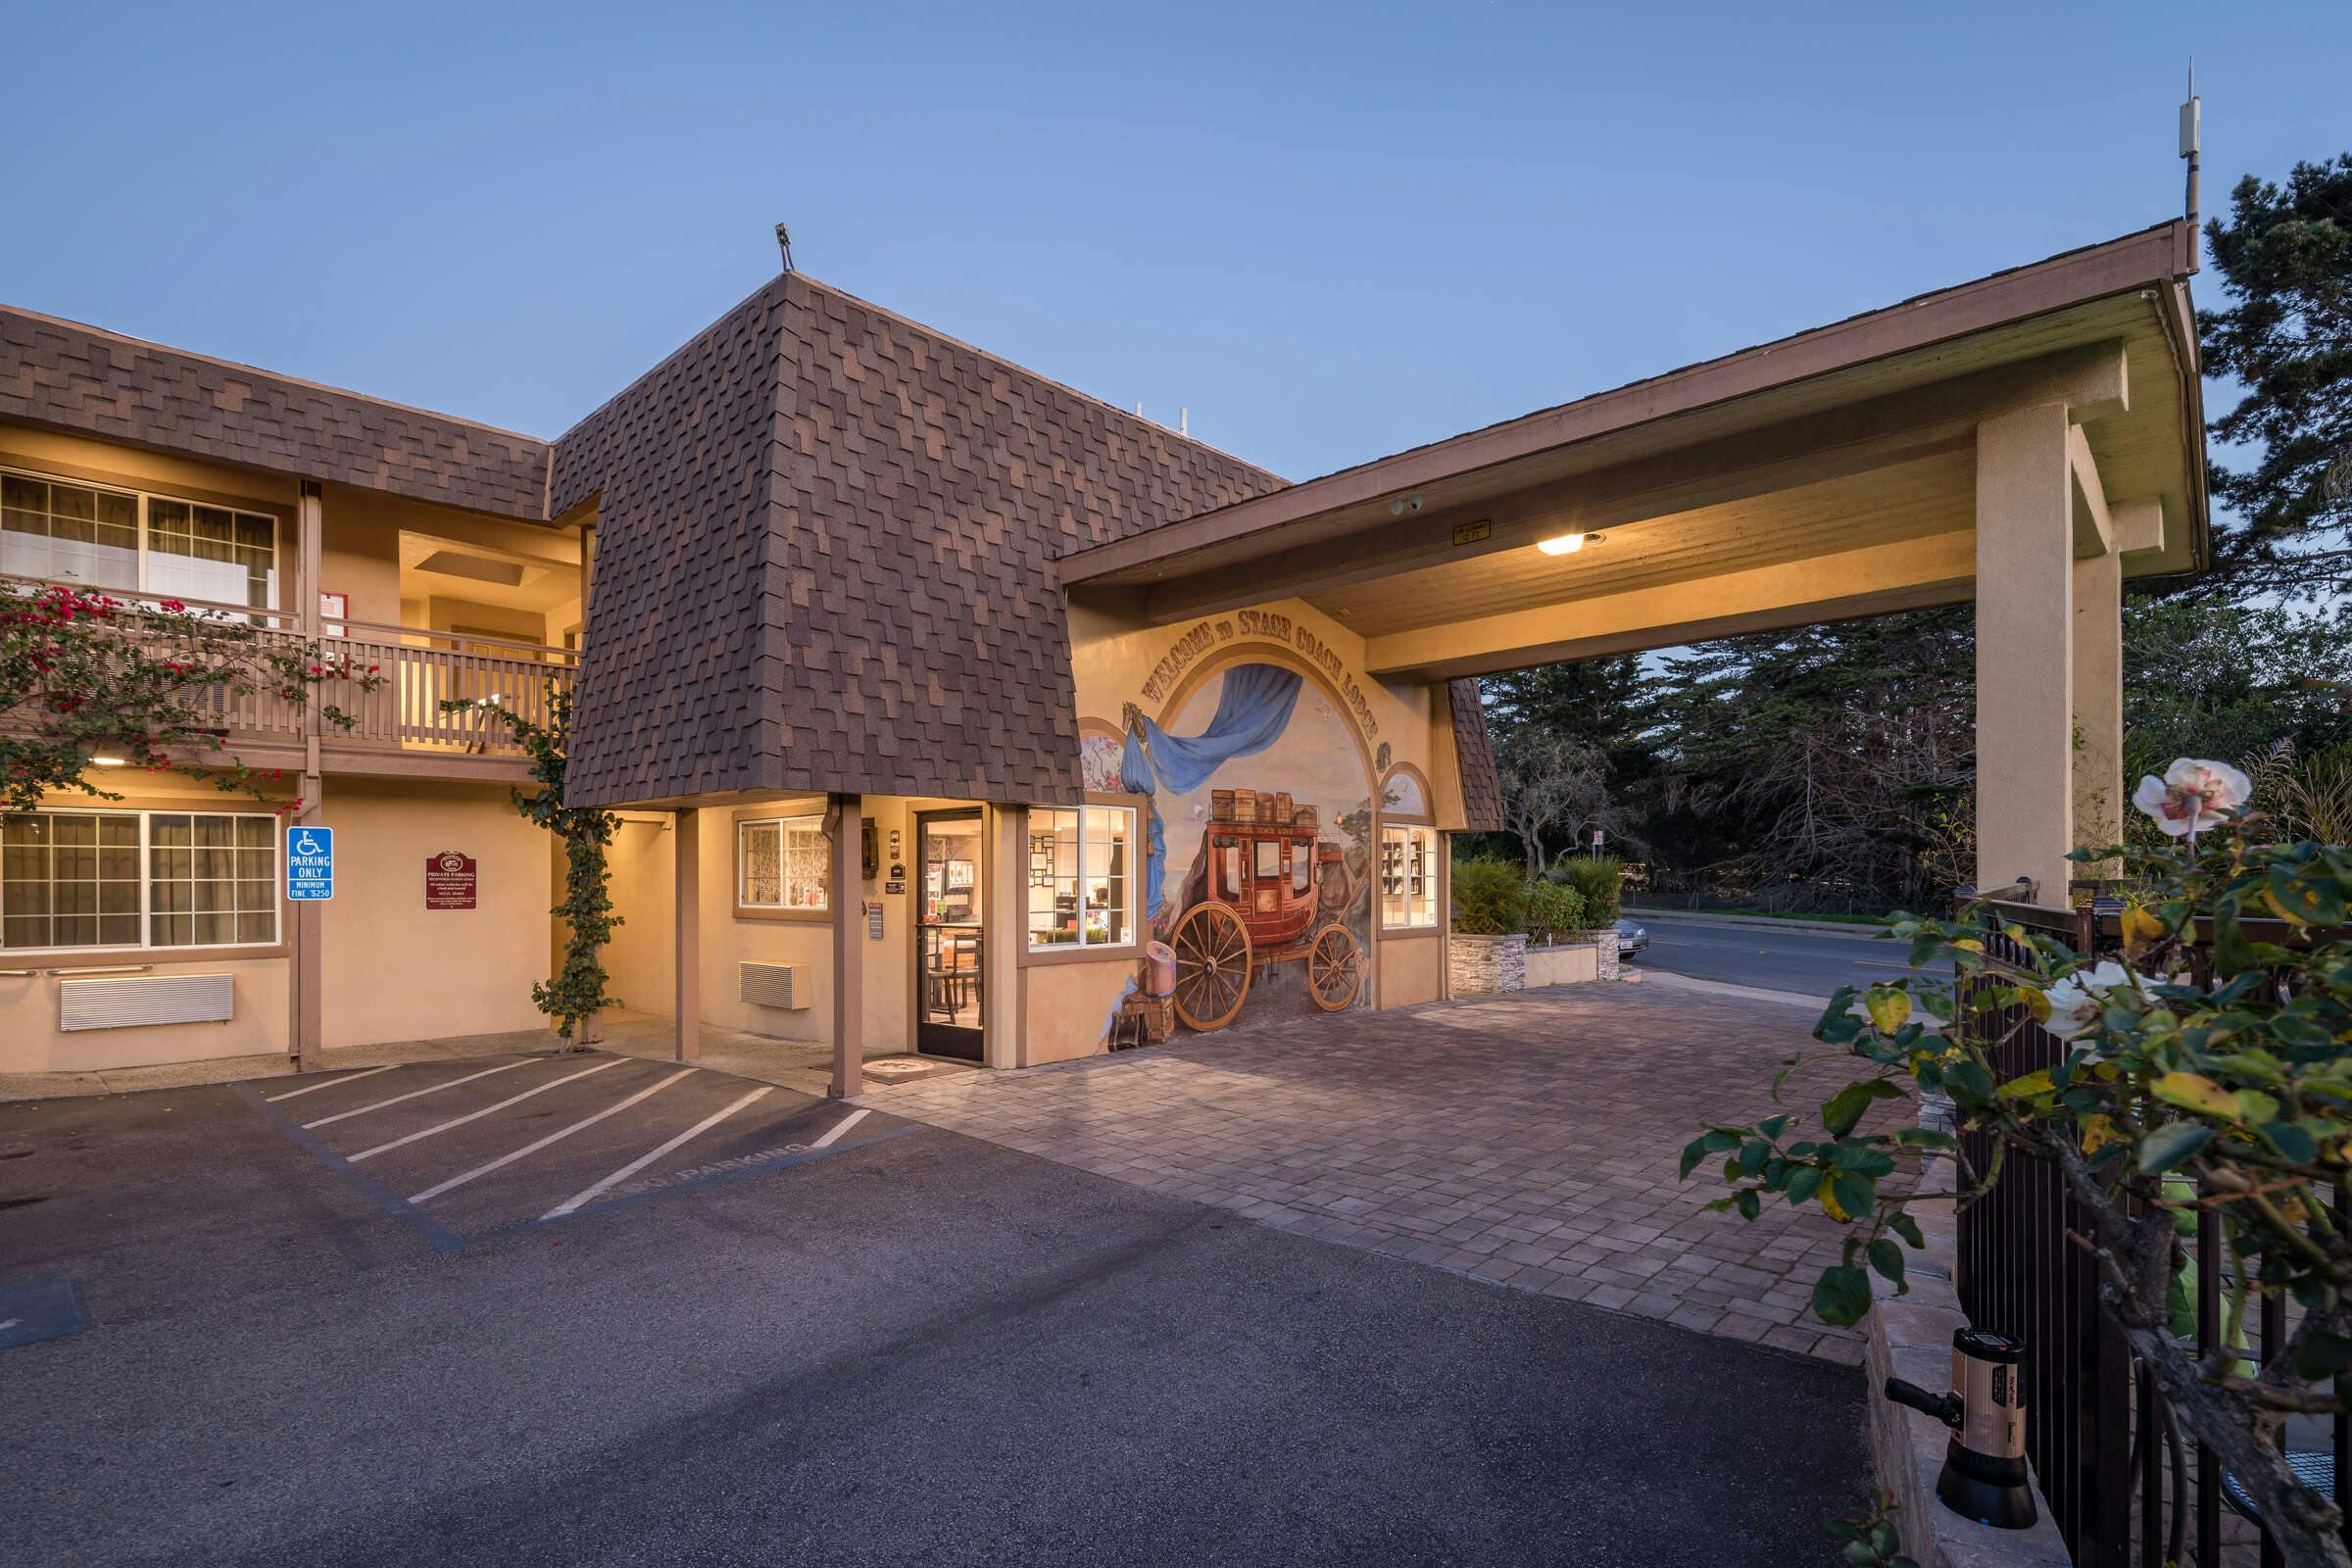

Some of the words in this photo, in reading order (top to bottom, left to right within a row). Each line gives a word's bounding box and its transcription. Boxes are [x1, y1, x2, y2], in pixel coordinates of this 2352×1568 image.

[1140, 620, 1215, 703] WELCOME
[1215, 620, 1233, 641] TO
[1237, 610, 1291, 643] STAGE
[1296, 626, 1342, 681] COACH
[1342, 671, 1379, 741] LODGE
[290, 856, 330, 866] PARKING
[298, 867, 322, 878] ONLY
[673, 1143, 809, 1181] PARKING
